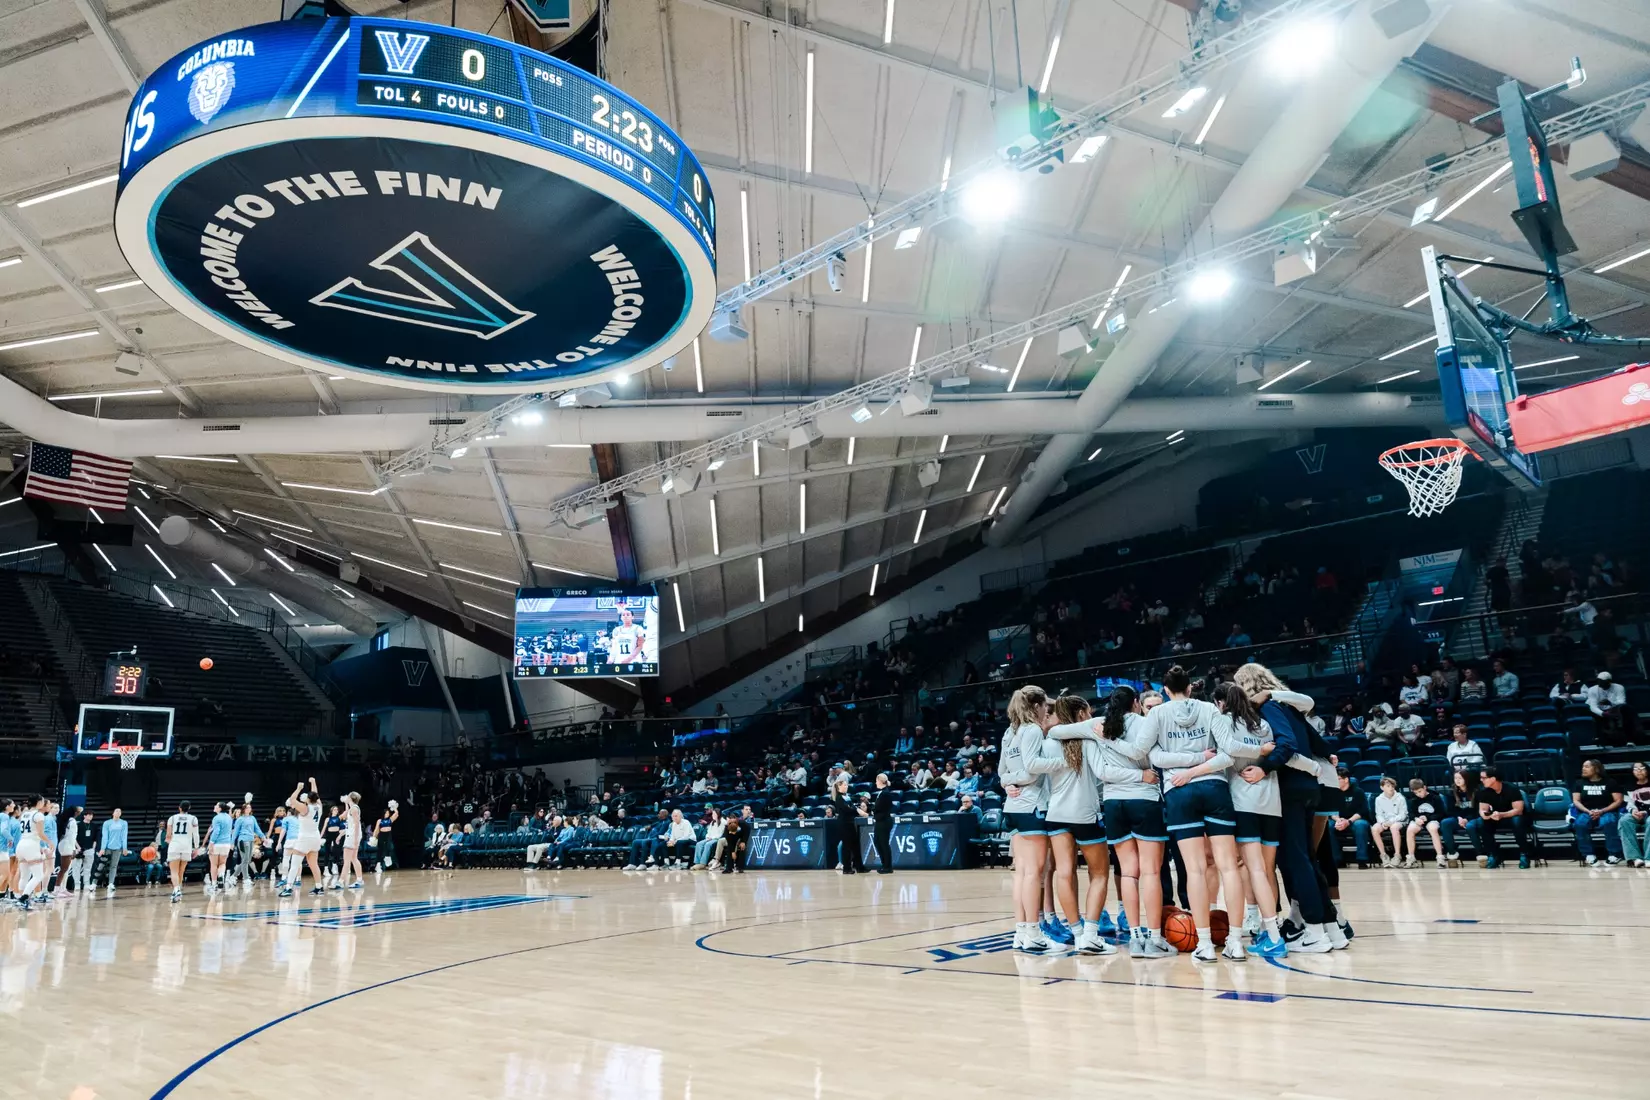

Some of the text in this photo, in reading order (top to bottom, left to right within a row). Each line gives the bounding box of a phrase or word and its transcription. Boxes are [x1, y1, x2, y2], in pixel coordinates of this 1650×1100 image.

[177, 39, 255, 81] COLUMBIA
[462, 49, 485, 81] 0
[534, 68, 563, 87] POSS
[374, 86, 504, 119] TOL 4 FOULS 0
[123, 90, 158, 169] VS
[592, 95, 653, 153] 2:23
[573, 130, 652, 184] PERIOD 0
[693, 173, 702, 203] 0
[200, 170, 503, 330] WELCOME TO THE FINN
[385, 243, 645, 373] WELCOME TO THE FINN
[118, 665, 142, 677] 2:22
[615, 665, 620, 673] 0
[114, 677, 137, 694] 30
[1167, 731, 1186, 739] ONLY
[1243, 736, 1261, 745] ONLY
[313, 810, 319, 822] 4
[20, 820, 31, 833] 34
[174, 822, 188, 834] 11
[773, 838, 791, 855] VS
[895, 835, 916, 853] VS
